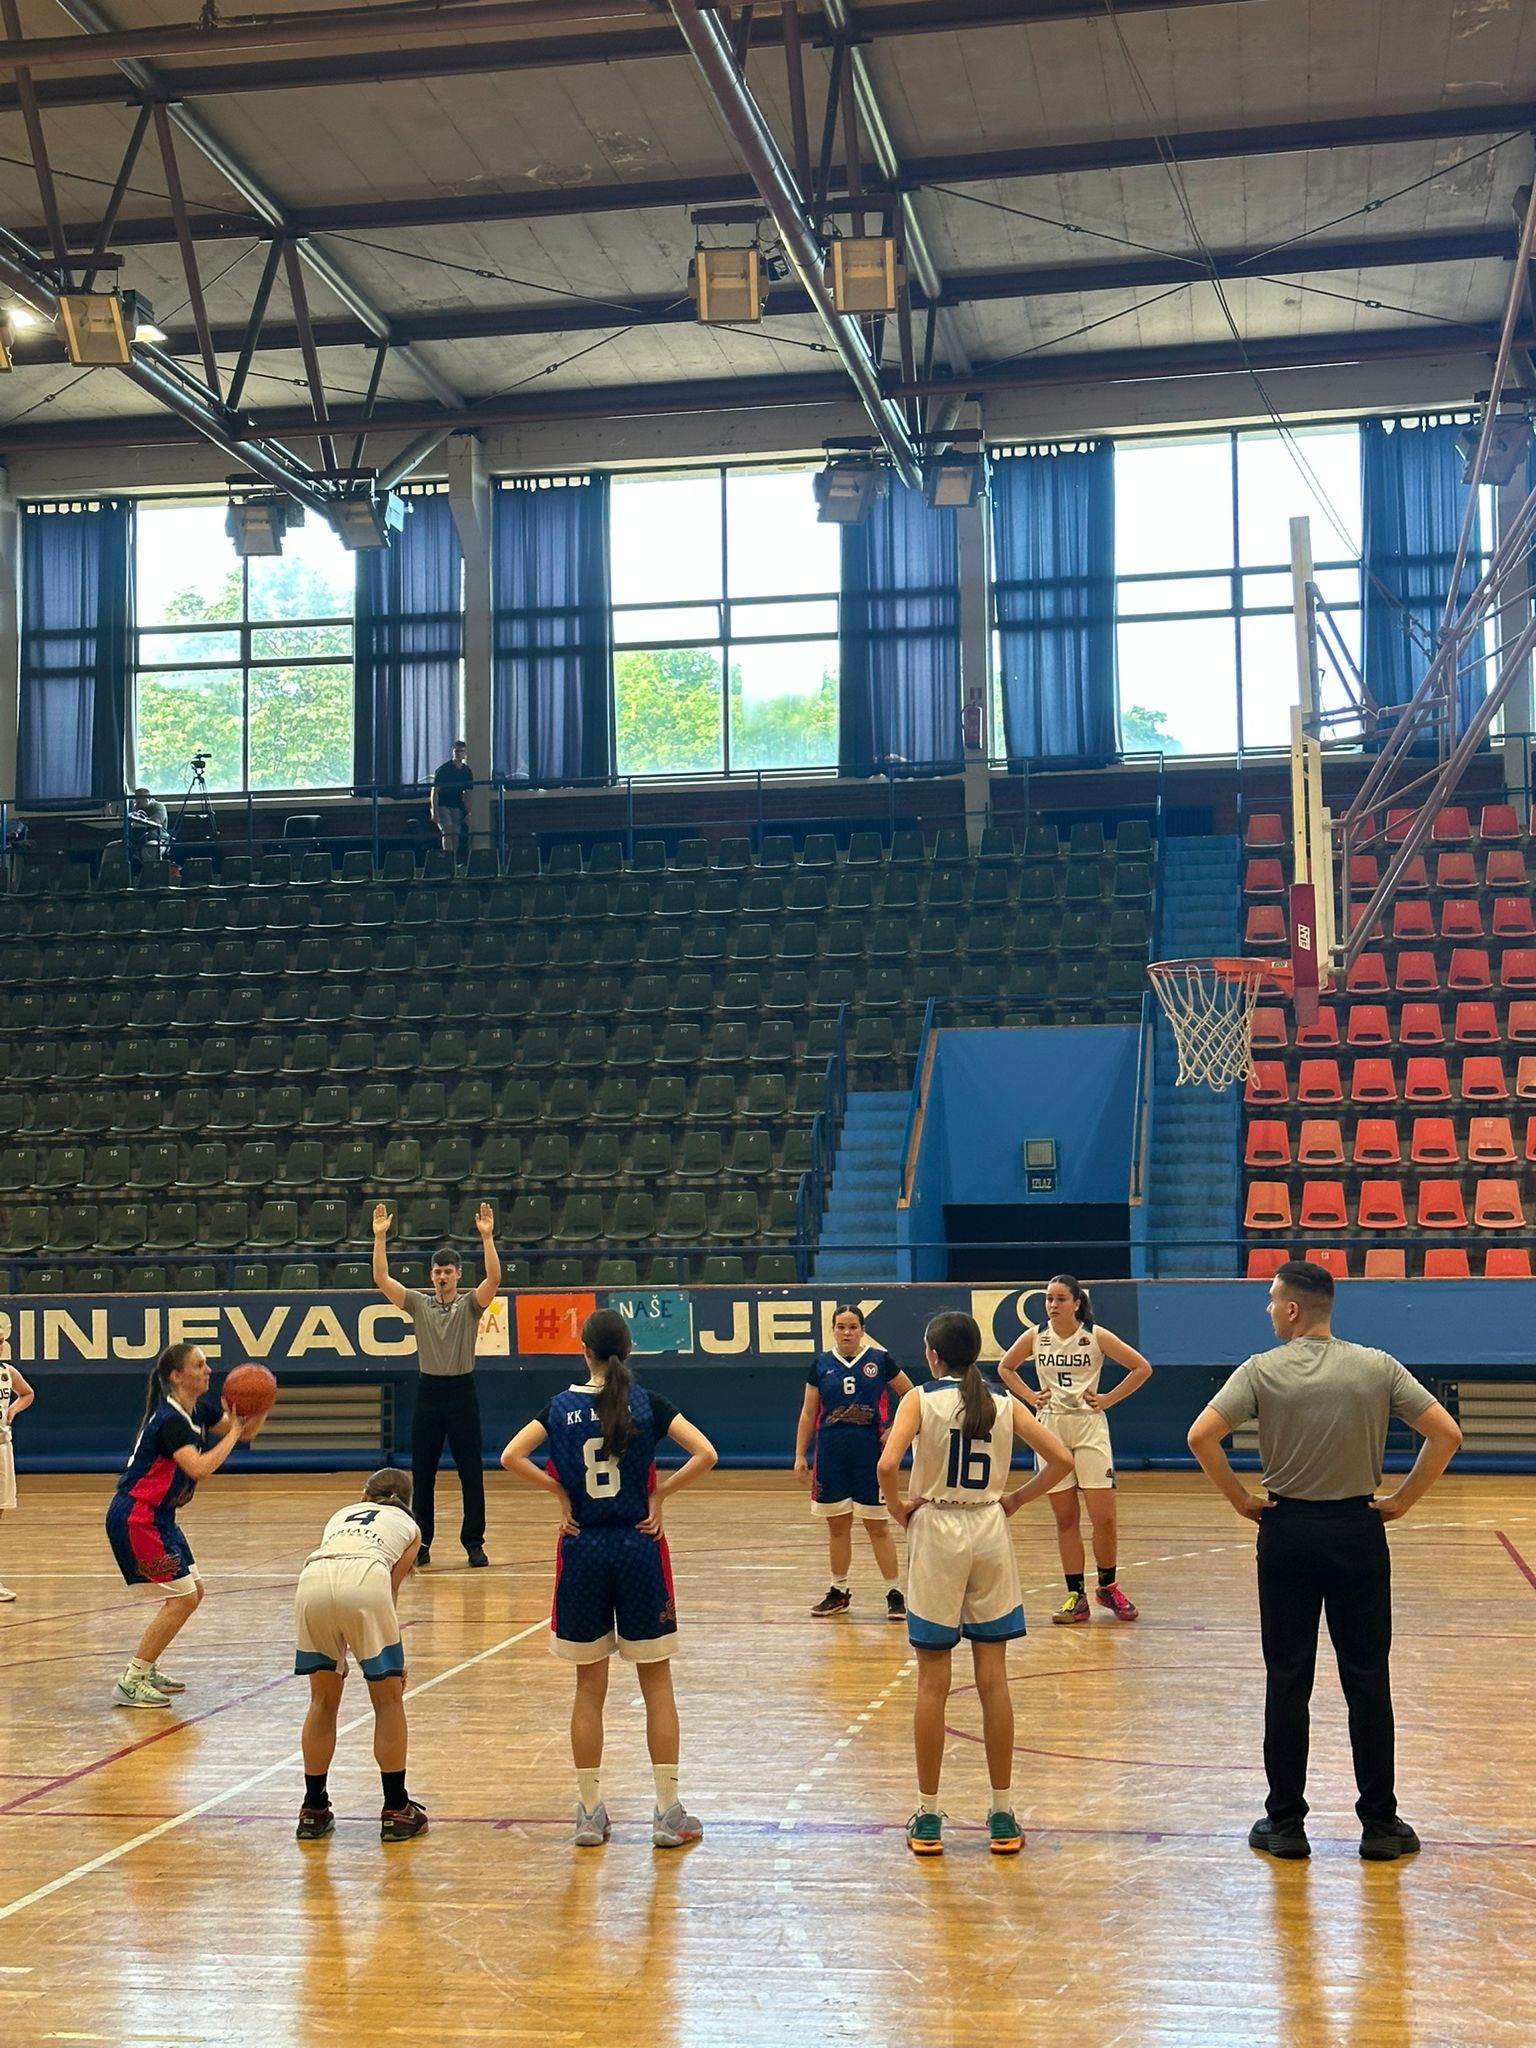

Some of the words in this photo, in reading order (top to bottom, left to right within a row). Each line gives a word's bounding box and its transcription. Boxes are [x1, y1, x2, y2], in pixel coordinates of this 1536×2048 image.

[1070, 1015, 1076, 1023] 2
[823, 1022, 832, 1030] 14
[128, 1042, 138, 1050] 22
[169, 1041, 178, 1049] 21
[330, 1089, 338, 1097] 11
[376, 1087, 386, 1095] 10
[632, 1197, 639, 1205] 4
[325, 1203, 335, 1211] 10
[561, 1263, 567, 1271] 5
[668, 1261, 674, 1269] 3
[618, 1294, 673, 1319] NAŠE
[534, 1306, 579, 1341] #1
[675, 1300, 888, 1356] JEK
[0, 1304, 418, 1361] INJEVAC
[1037, 1353, 1092, 1368] RAGUSA
[1057, 1371, 1073, 1388] 15
[842, 1376, 857, 1395] 6
[566, 1409, 582, 1425] KK
[946, 1428, 992, 1490] 16
[344, 1509, 381, 1526] 4
